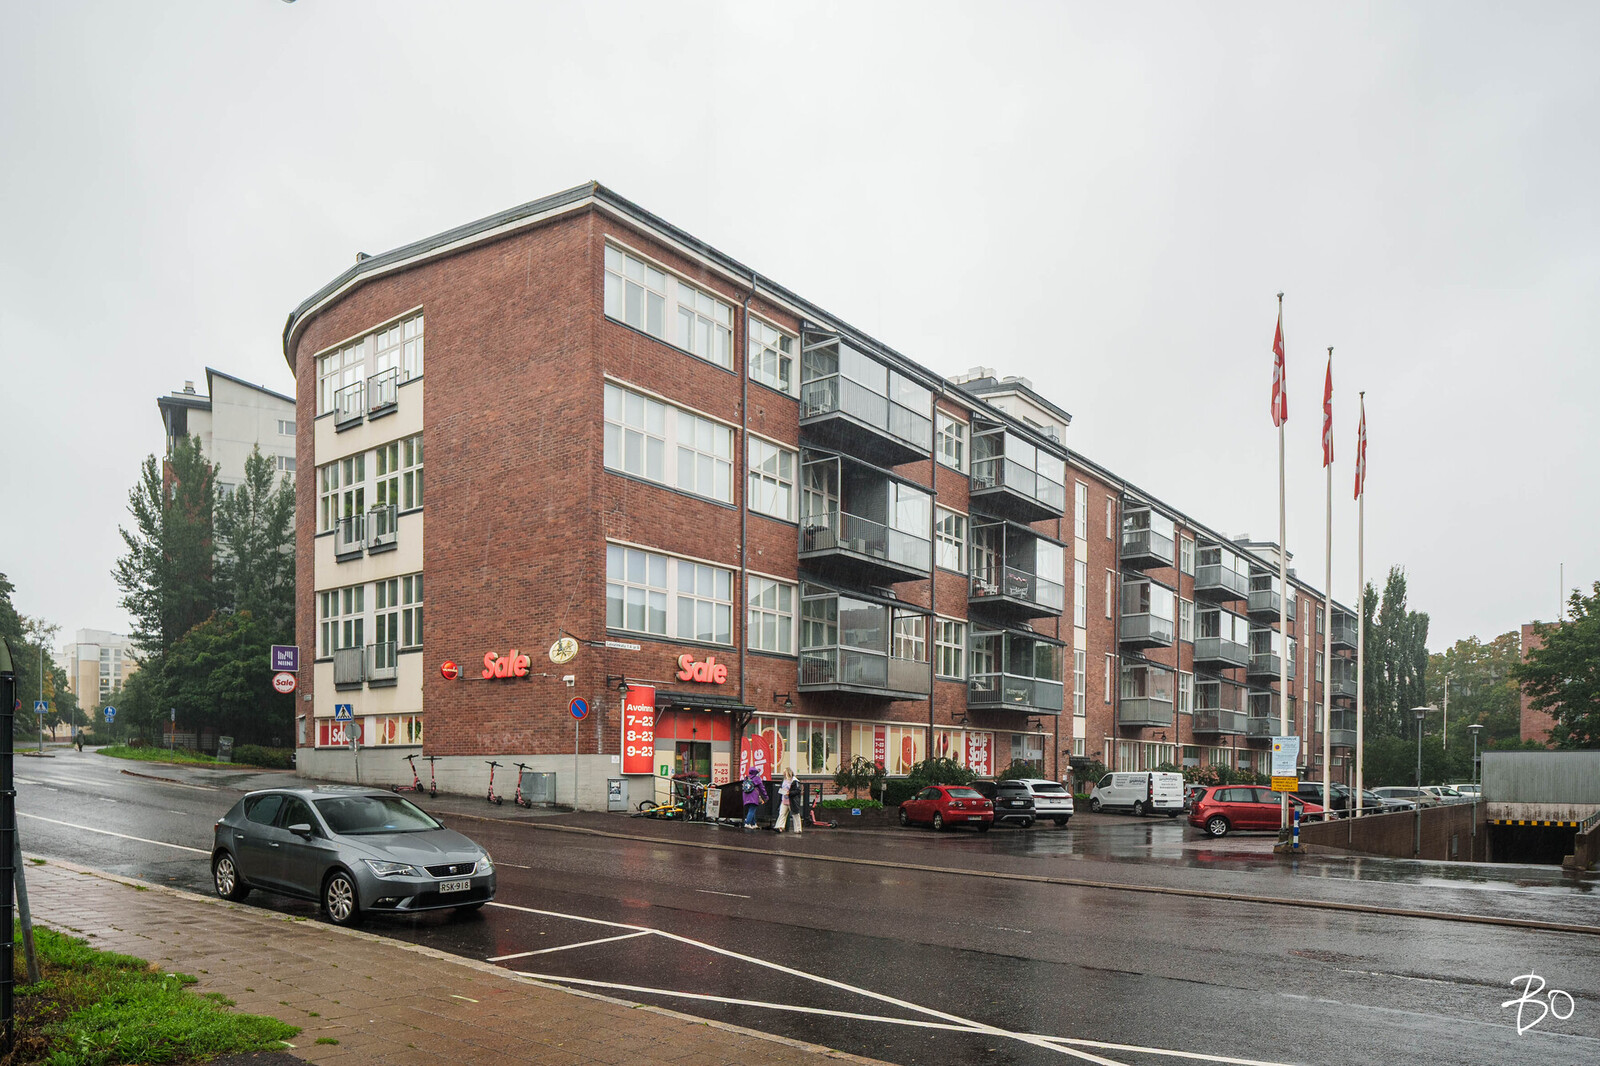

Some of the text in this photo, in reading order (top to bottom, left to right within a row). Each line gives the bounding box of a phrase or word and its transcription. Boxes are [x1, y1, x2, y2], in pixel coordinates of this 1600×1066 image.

[482, 649, 531, 680] Sale
[677, 654, 728, 685] Sale
[626, 703, 654, 713] Avoinna
[626, 715, 654, 727] 7-23
[626, 730, 654, 742] 8-23
[626, 745, 653, 757] 9-23
[441, 881, 469, 892] RSK-918
